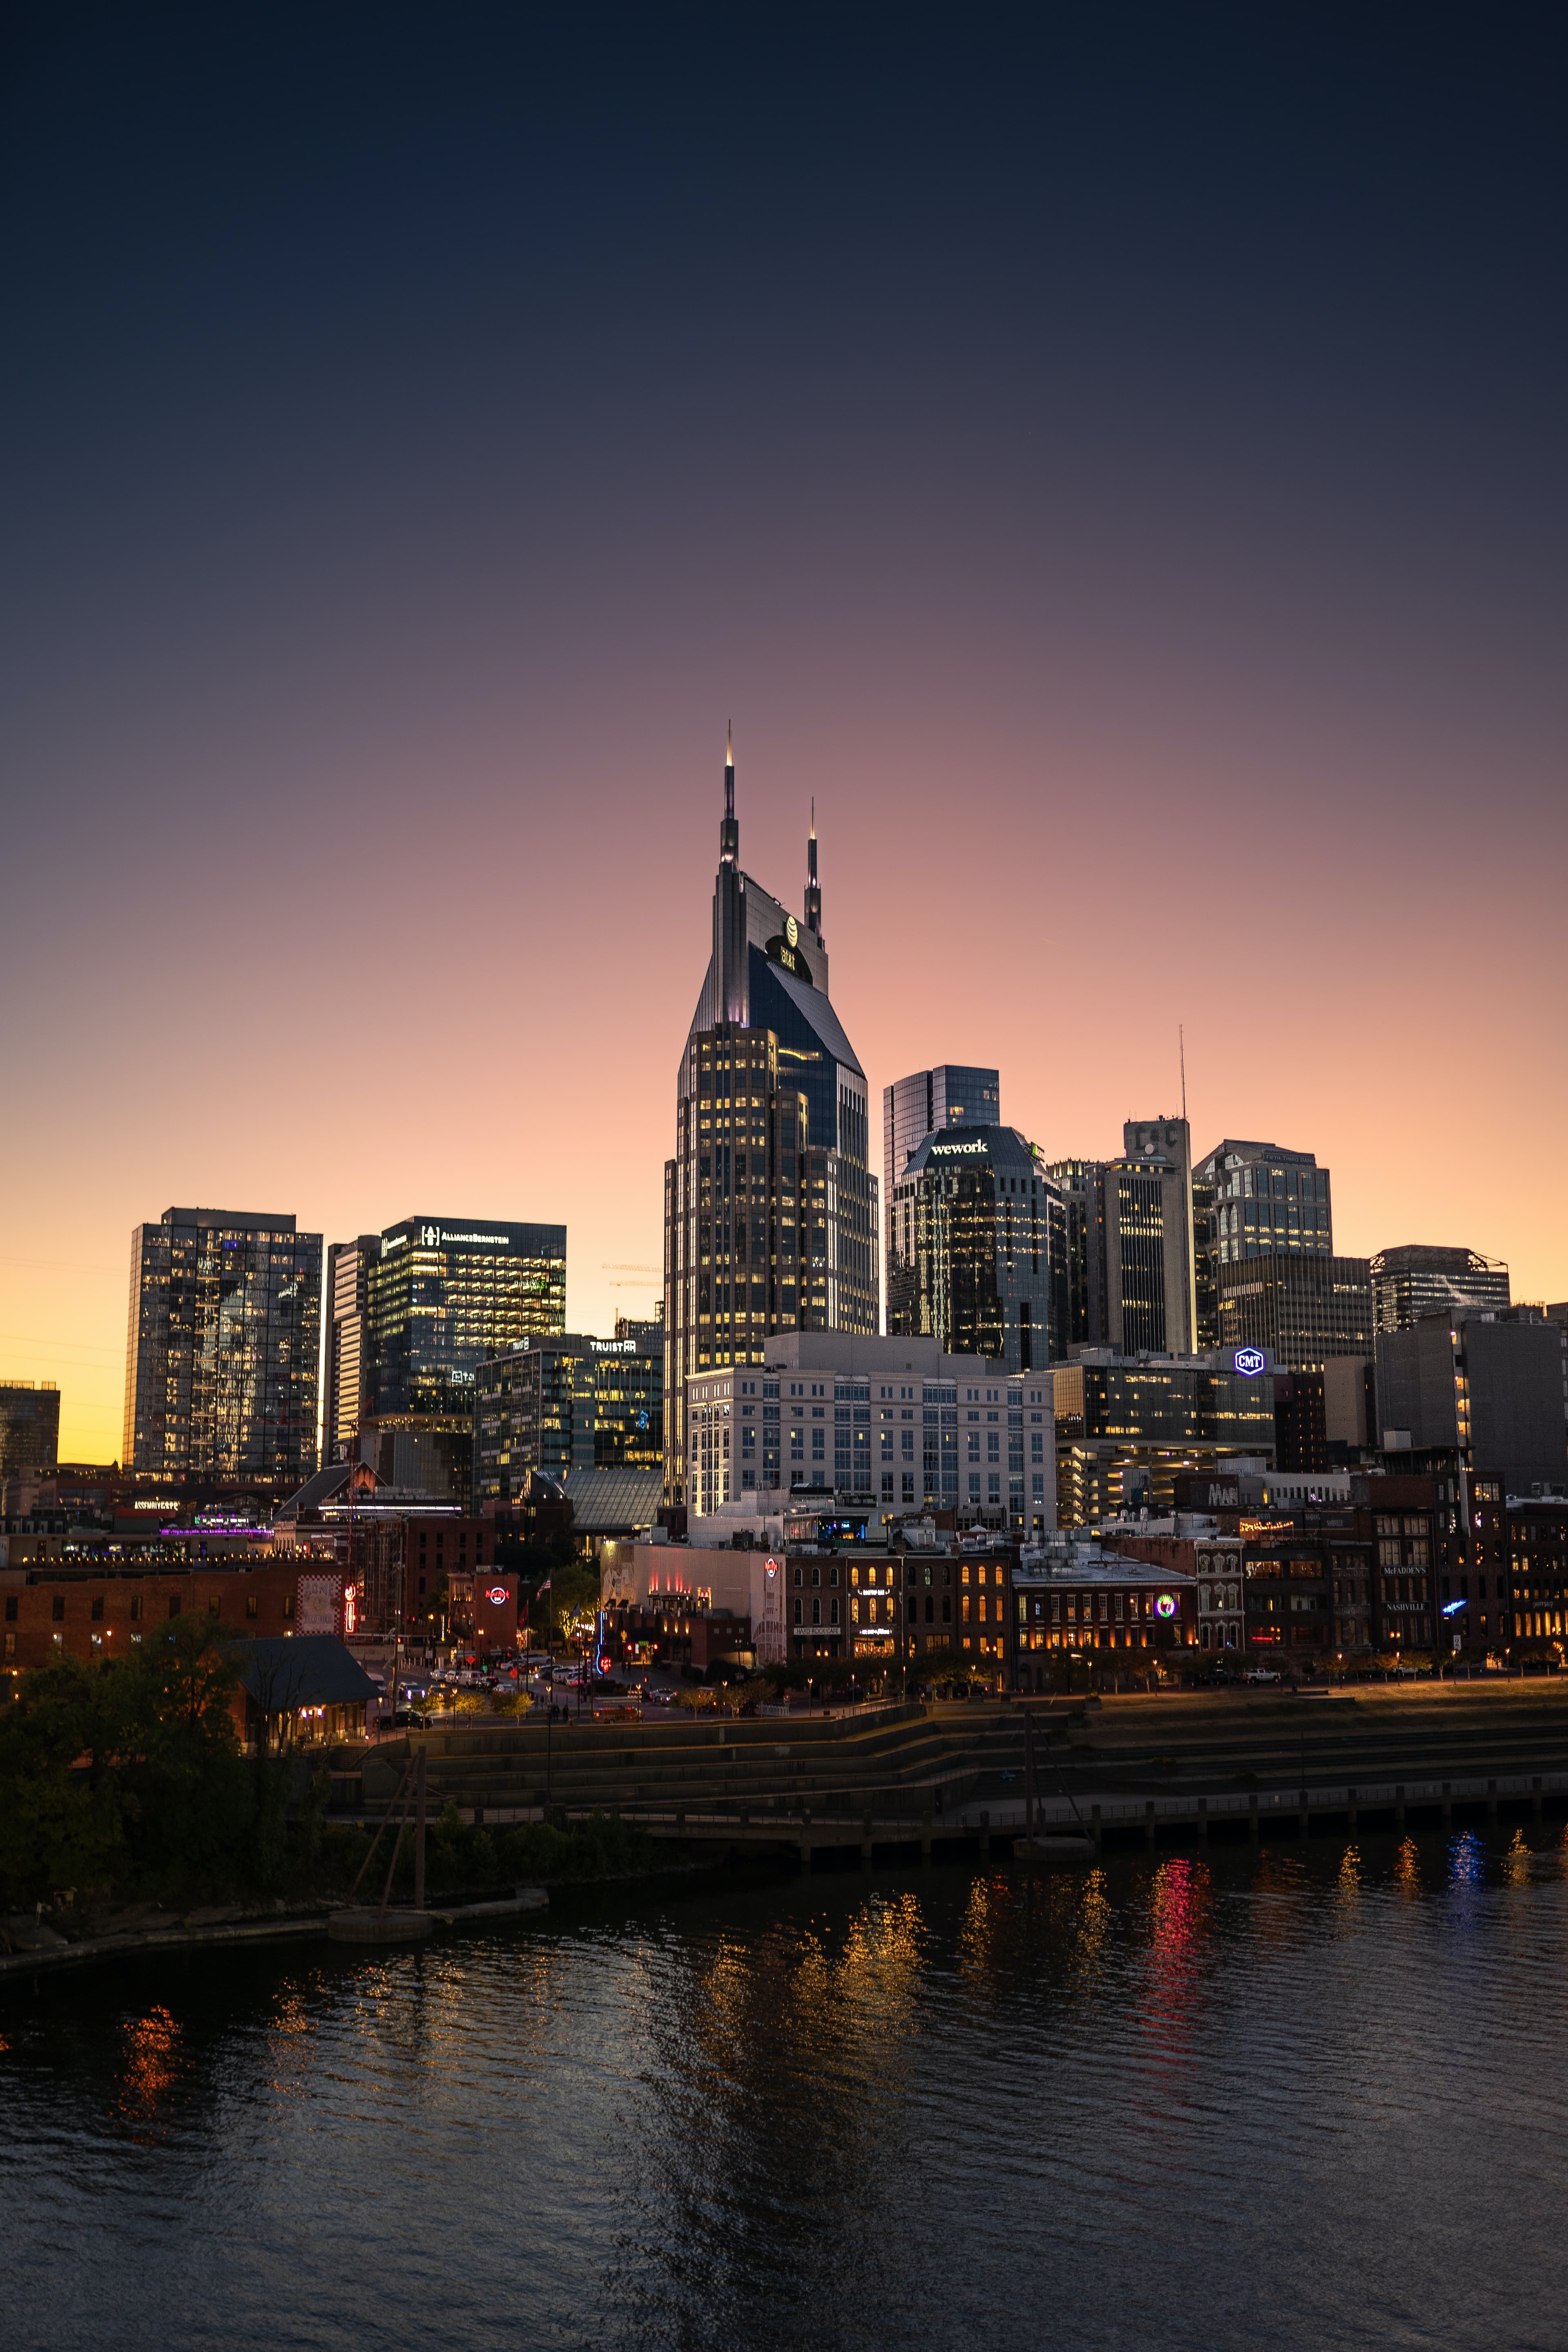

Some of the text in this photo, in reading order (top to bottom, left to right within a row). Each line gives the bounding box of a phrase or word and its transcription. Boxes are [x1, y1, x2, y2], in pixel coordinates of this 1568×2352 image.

[782, 949, 795, 971] at&t
[931, 1138, 988, 1155] wework
[590, 1341, 623, 1352] TRUIST
[1239, 1355, 1260, 1367] CMT
